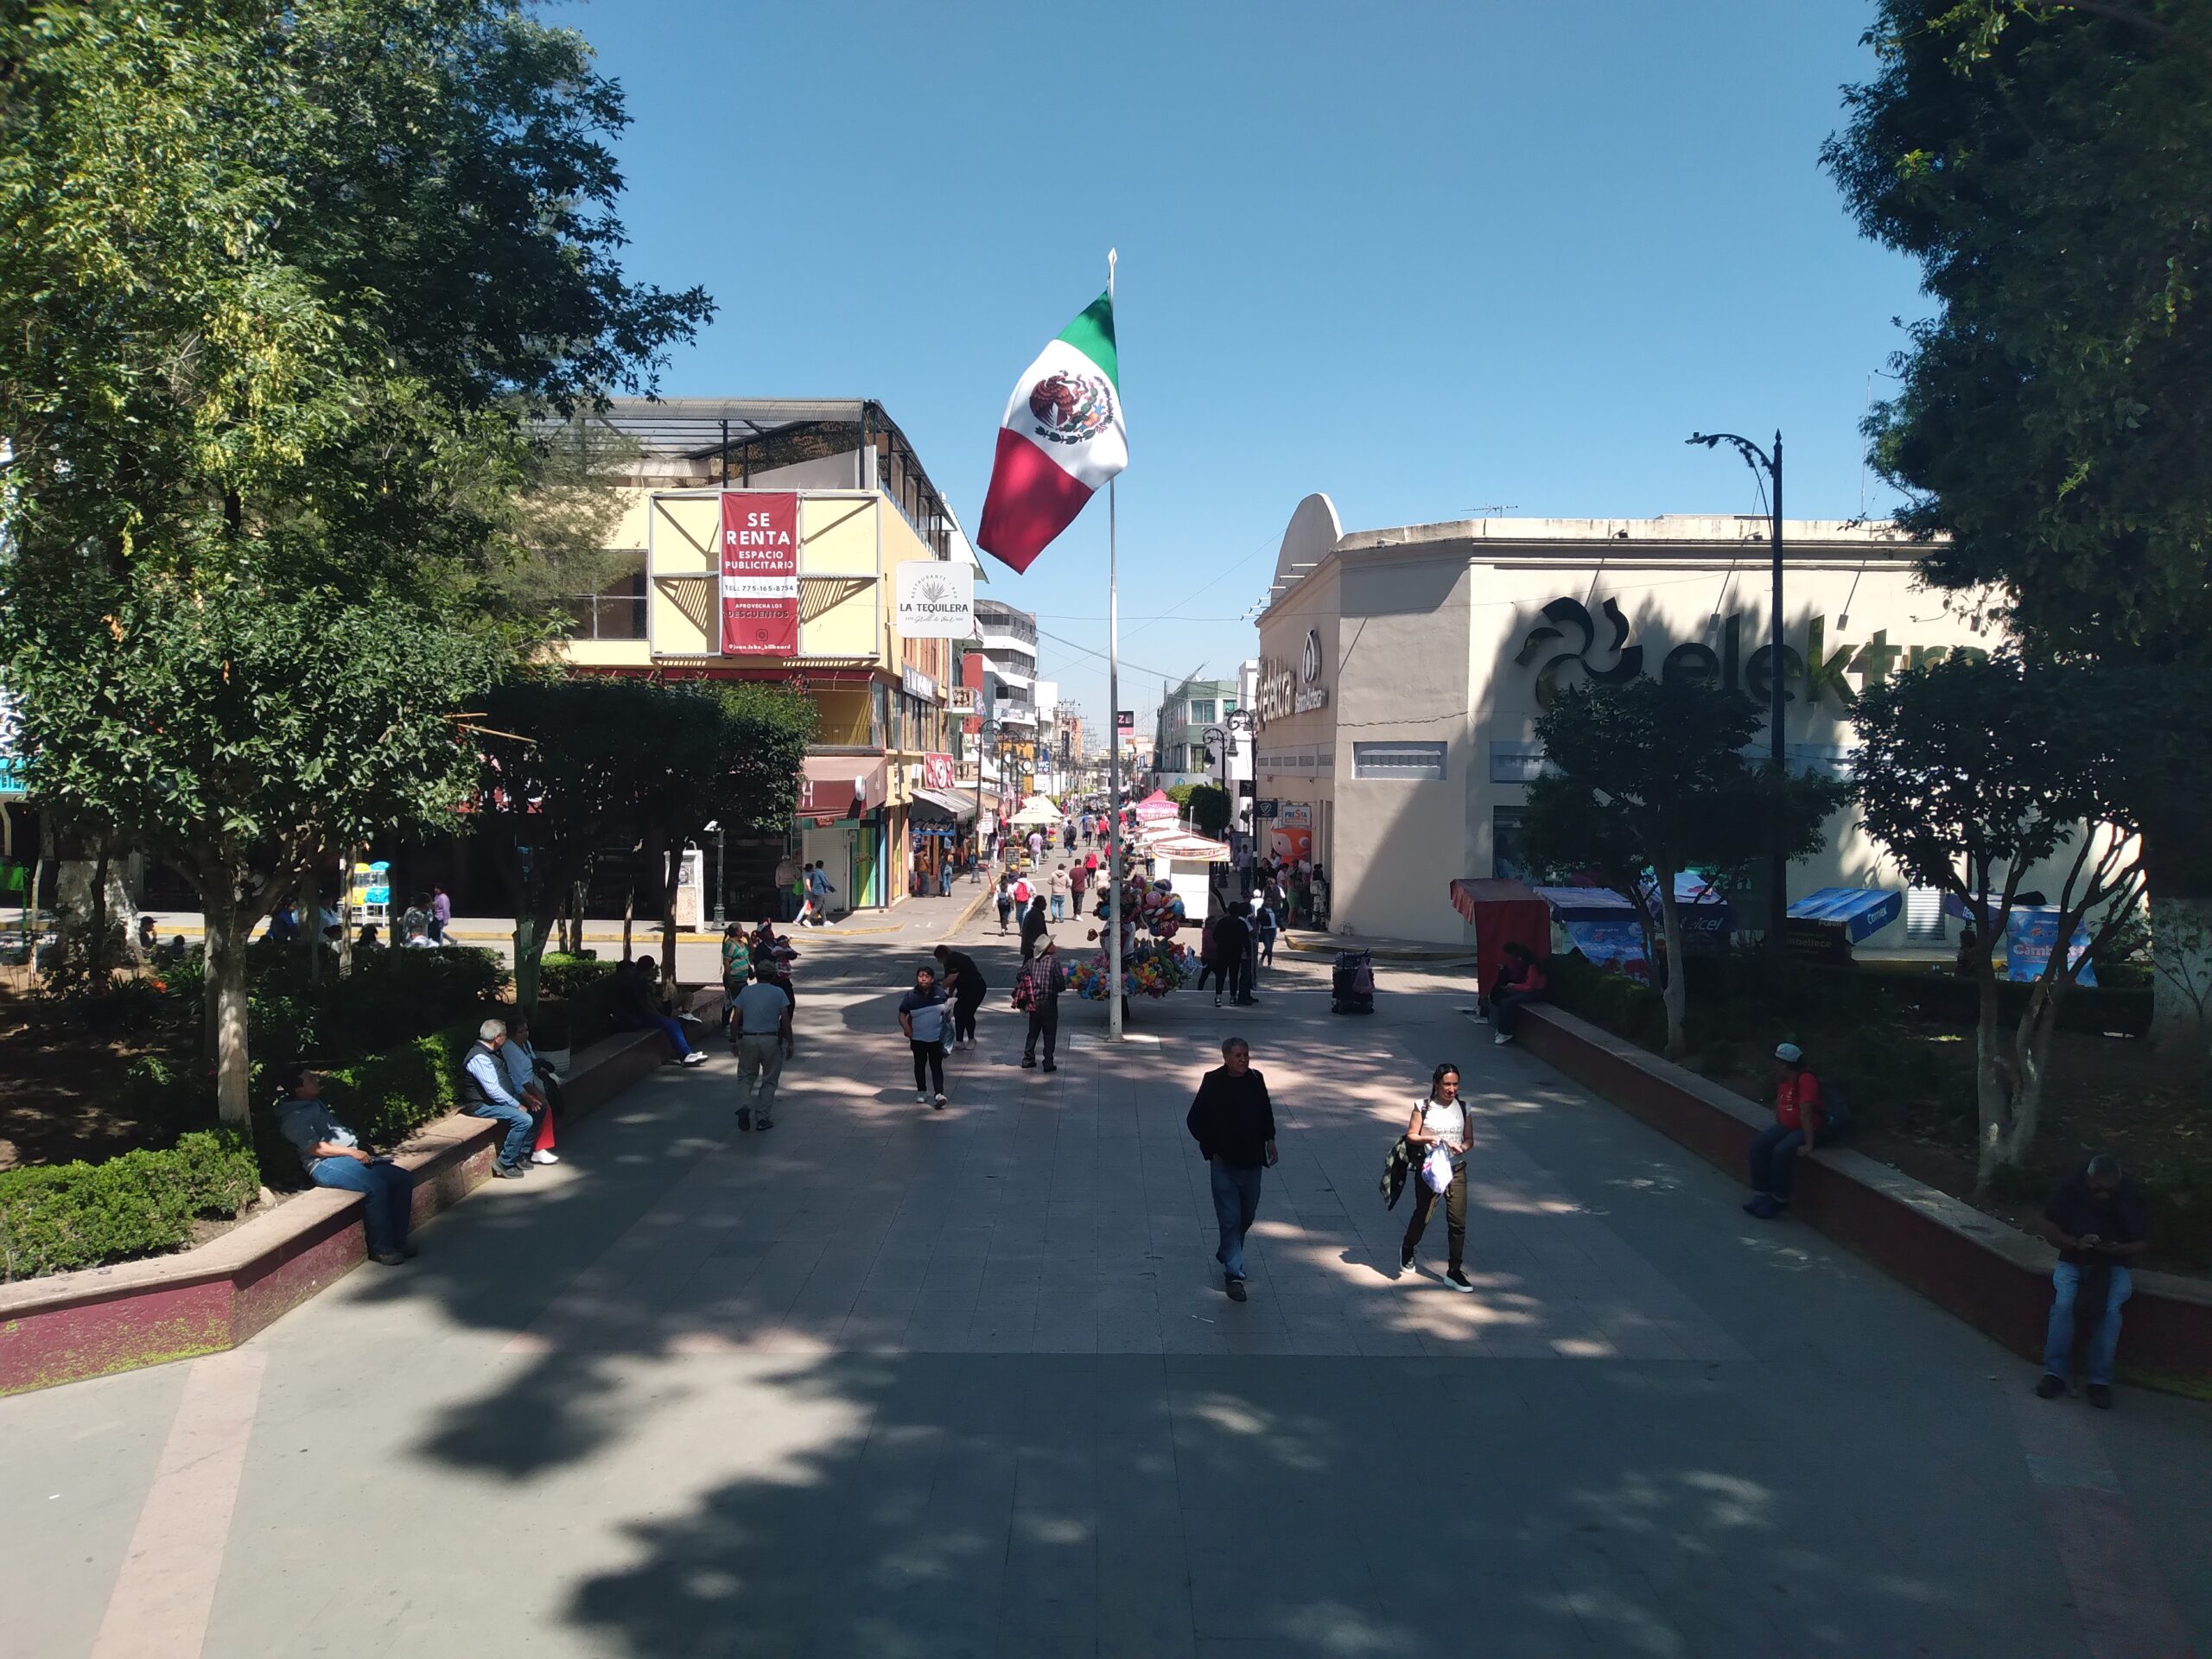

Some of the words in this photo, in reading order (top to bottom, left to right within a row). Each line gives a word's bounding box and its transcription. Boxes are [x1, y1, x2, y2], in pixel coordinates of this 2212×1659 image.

[747, 512, 770, 527] SE
[727, 531, 791, 545] RENTA
[725, 561, 793, 569] PUBLICITARIO
[899, 603, 912, 612] LA
[916, 603, 969, 613] TEQUILERA
[728, 610, 790, 619] DESCUENTOS
[922, 822, 952, 831] telcel
[1867, 904, 1887, 925] Comex
